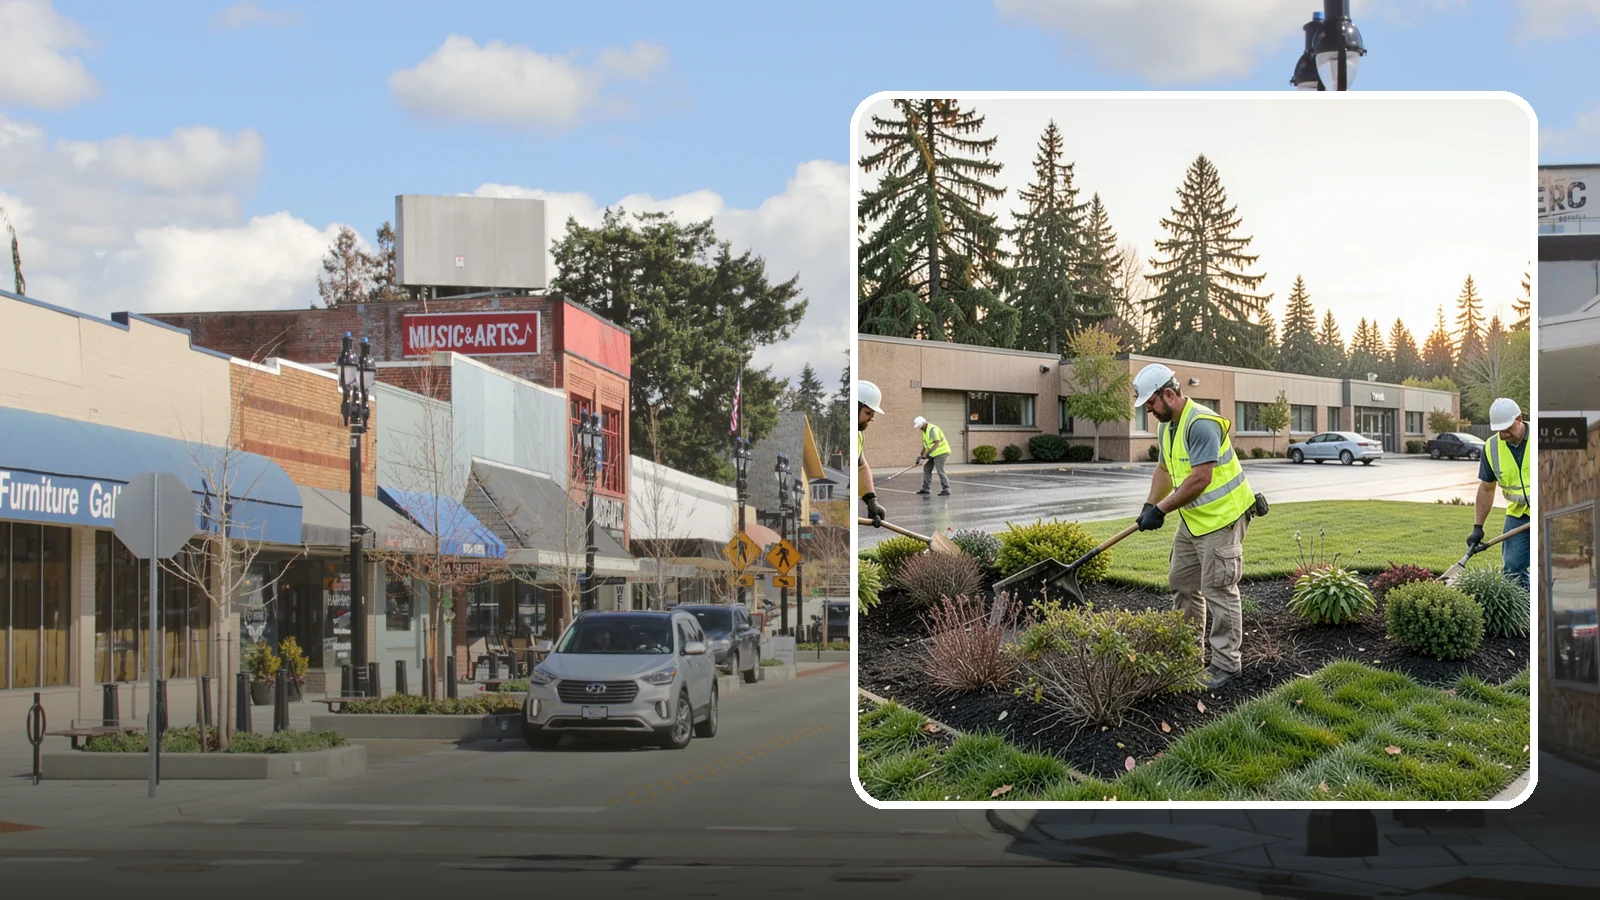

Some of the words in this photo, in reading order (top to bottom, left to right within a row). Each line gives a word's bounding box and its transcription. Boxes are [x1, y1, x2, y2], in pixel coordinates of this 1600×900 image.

[408, 323, 519, 349] MUSIC&ARTS
[1540, 427, 1577, 437] UGA
[0, 471, 79, 515] Furniture
[453, 563, 479, 574] SUSHI
